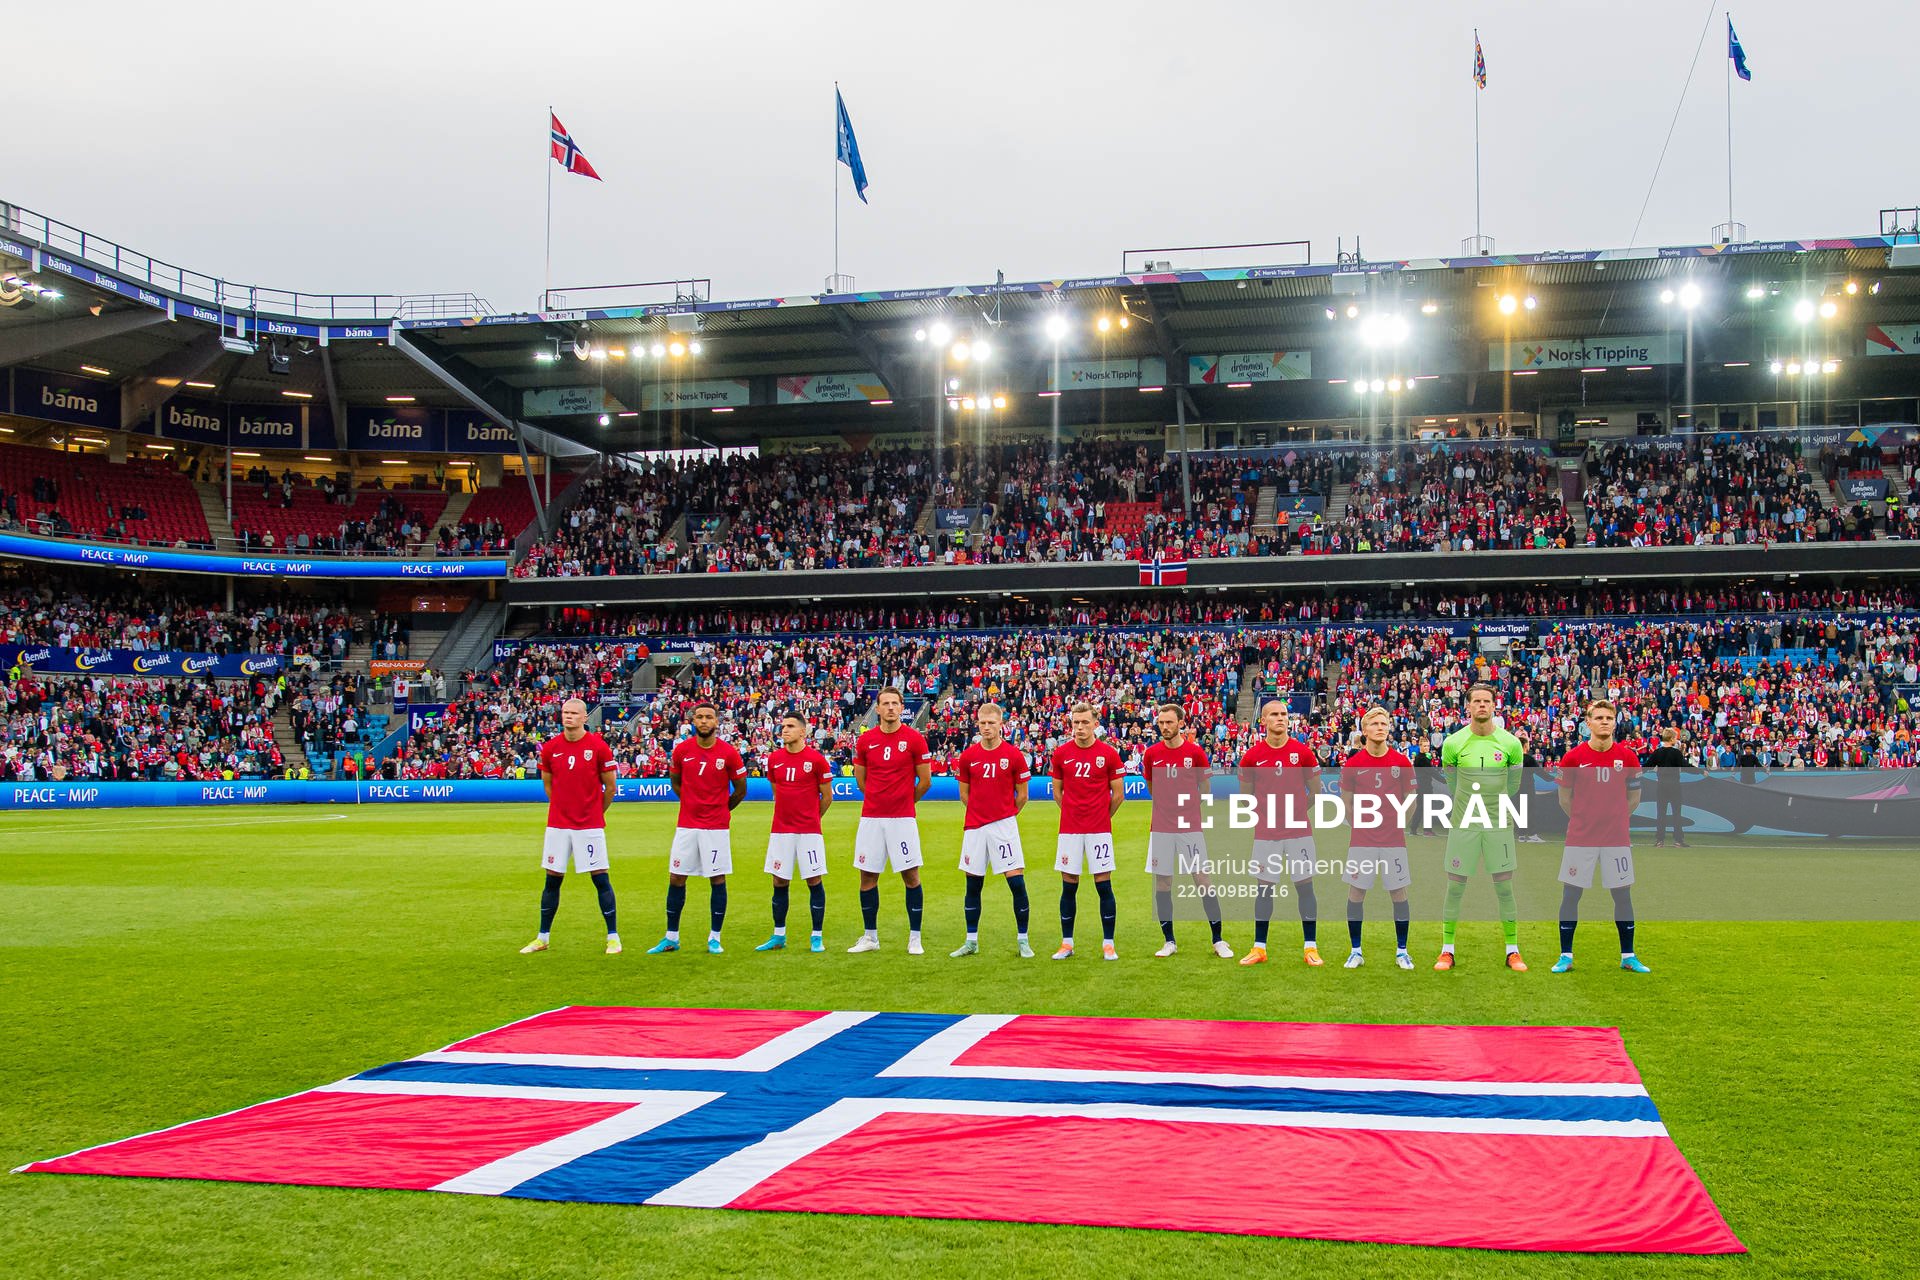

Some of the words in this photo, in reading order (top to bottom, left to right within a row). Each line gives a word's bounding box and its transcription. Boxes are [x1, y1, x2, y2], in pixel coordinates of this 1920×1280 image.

[48, 255, 72, 273] bama
[95, 272, 118, 290] bama
[139, 288, 160, 305] bama
[193, 306, 218, 321] bama
[268, 321, 297, 334] bama
[345, 326, 372, 336] bama
[1548, 347, 1591, 362] Norsk
[1594, 345, 1649, 362] Tipping
[1085, 371, 1110, 380] Norsk
[1111, 370, 1143, 380] Tipping
[42, 385, 98, 412] bama
[676, 392, 698, 401] Norsk
[699, 390, 728, 402] Tipping
[170, 404, 221, 430] bama
[239, 415, 294, 435] bama
[368, 418, 423, 437] bama
[467, 421, 516, 440] bama
[1813, 432, 1841, 445] sjanse!
[1625, 441, 1650, 450] Nrsk
[1654, 441, 1682, 451] ipping
[81, 549, 114, 561] PEACE
[243, 561, 276, 572] PEACE
[402, 565, 433, 574] PEACE
[1484, 624, 1506, 632] Norsk
[1507, 624, 1530, 634] Tippin
[1565, 623, 1587, 631] Norsk
[671, 641, 690, 649] Norsk
[24, 648, 51, 663] Bendit
[84, 651, 112, 666] Bendit
[141, 654, 171, 668] Bendit
[190, 655, 220, 670] Bendit
[249, 656, 279, 671] Bendit
[883, 747, 891, 761] 8
[568, 756, 575, 770] 9
[698, 762, 707, 776] 7
[1074, 762, 1091, 778] 22
[1275, 760, 1282, 776] 3
[1480, 756, 1484, 771] 1
[786, 768, 796, 781] 11
[982, 763, 996, 778] 21
[1166, 763, 1178, 778] 16
[1596, 766, 1610, 782] 10
[1125, 781, 1145, 794] ИР
[1375, 773, 1382, 788] 5
[14, 788, 56, 803] PEACE
[68, 788, 99, 802] МИР
[202, 786, 234, 800] PEACE
[244, 786, 267, 798] МИР
[369, 786, 410, 798] PEACE
[423, 786, 454, 798] МИР
[639, 784, 672, 797] МИР
[587, 844, 594, 858] 9
[900, 841, 909, 855] 8
[998, 843, 1013, 859] 21
[1094, 843, 1110, 859] 22
[1186, 844, 1200, 858] 16
[1301, 848, 1309, 862] 3
[1503, 844, 1508, 858] 1
[711, 850, 718, 864] 7
[807, 850, 818, 865] 11
[1394, 858, 1402, 873] 5
[1614, 856, 1629, 873] 10
